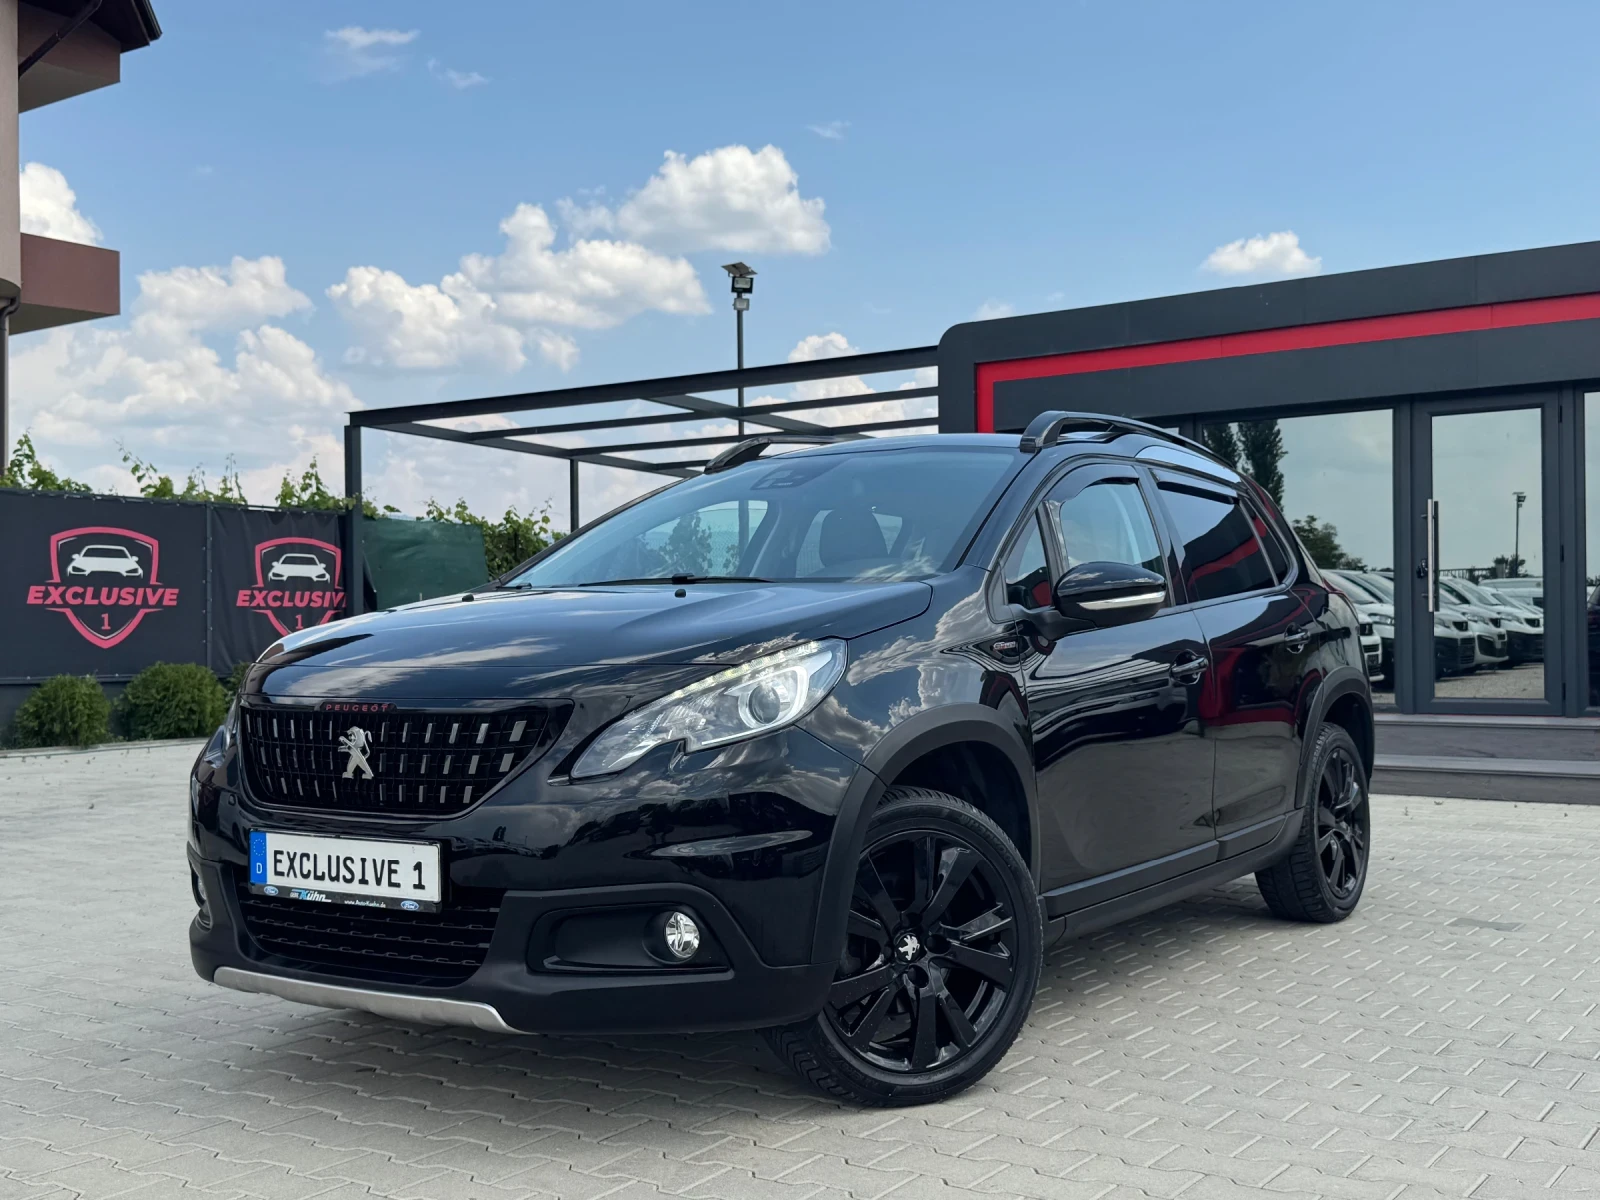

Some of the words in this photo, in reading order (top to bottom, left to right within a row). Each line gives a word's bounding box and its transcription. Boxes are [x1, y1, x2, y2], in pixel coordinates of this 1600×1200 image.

[26, 585, 180, 606] EXCLUSIVE
[235, 590, 346, 608] EXCLUSIV
[101, 613, 111, 630] 1
[295, 614, 304, 630] 1
[325, 703, 388, 712] PEUGEOT
[255, 862, 263, 874] D
[273, 849, 401, 889] EXCLUSIVE
[412, 861, 426, 890] 1
